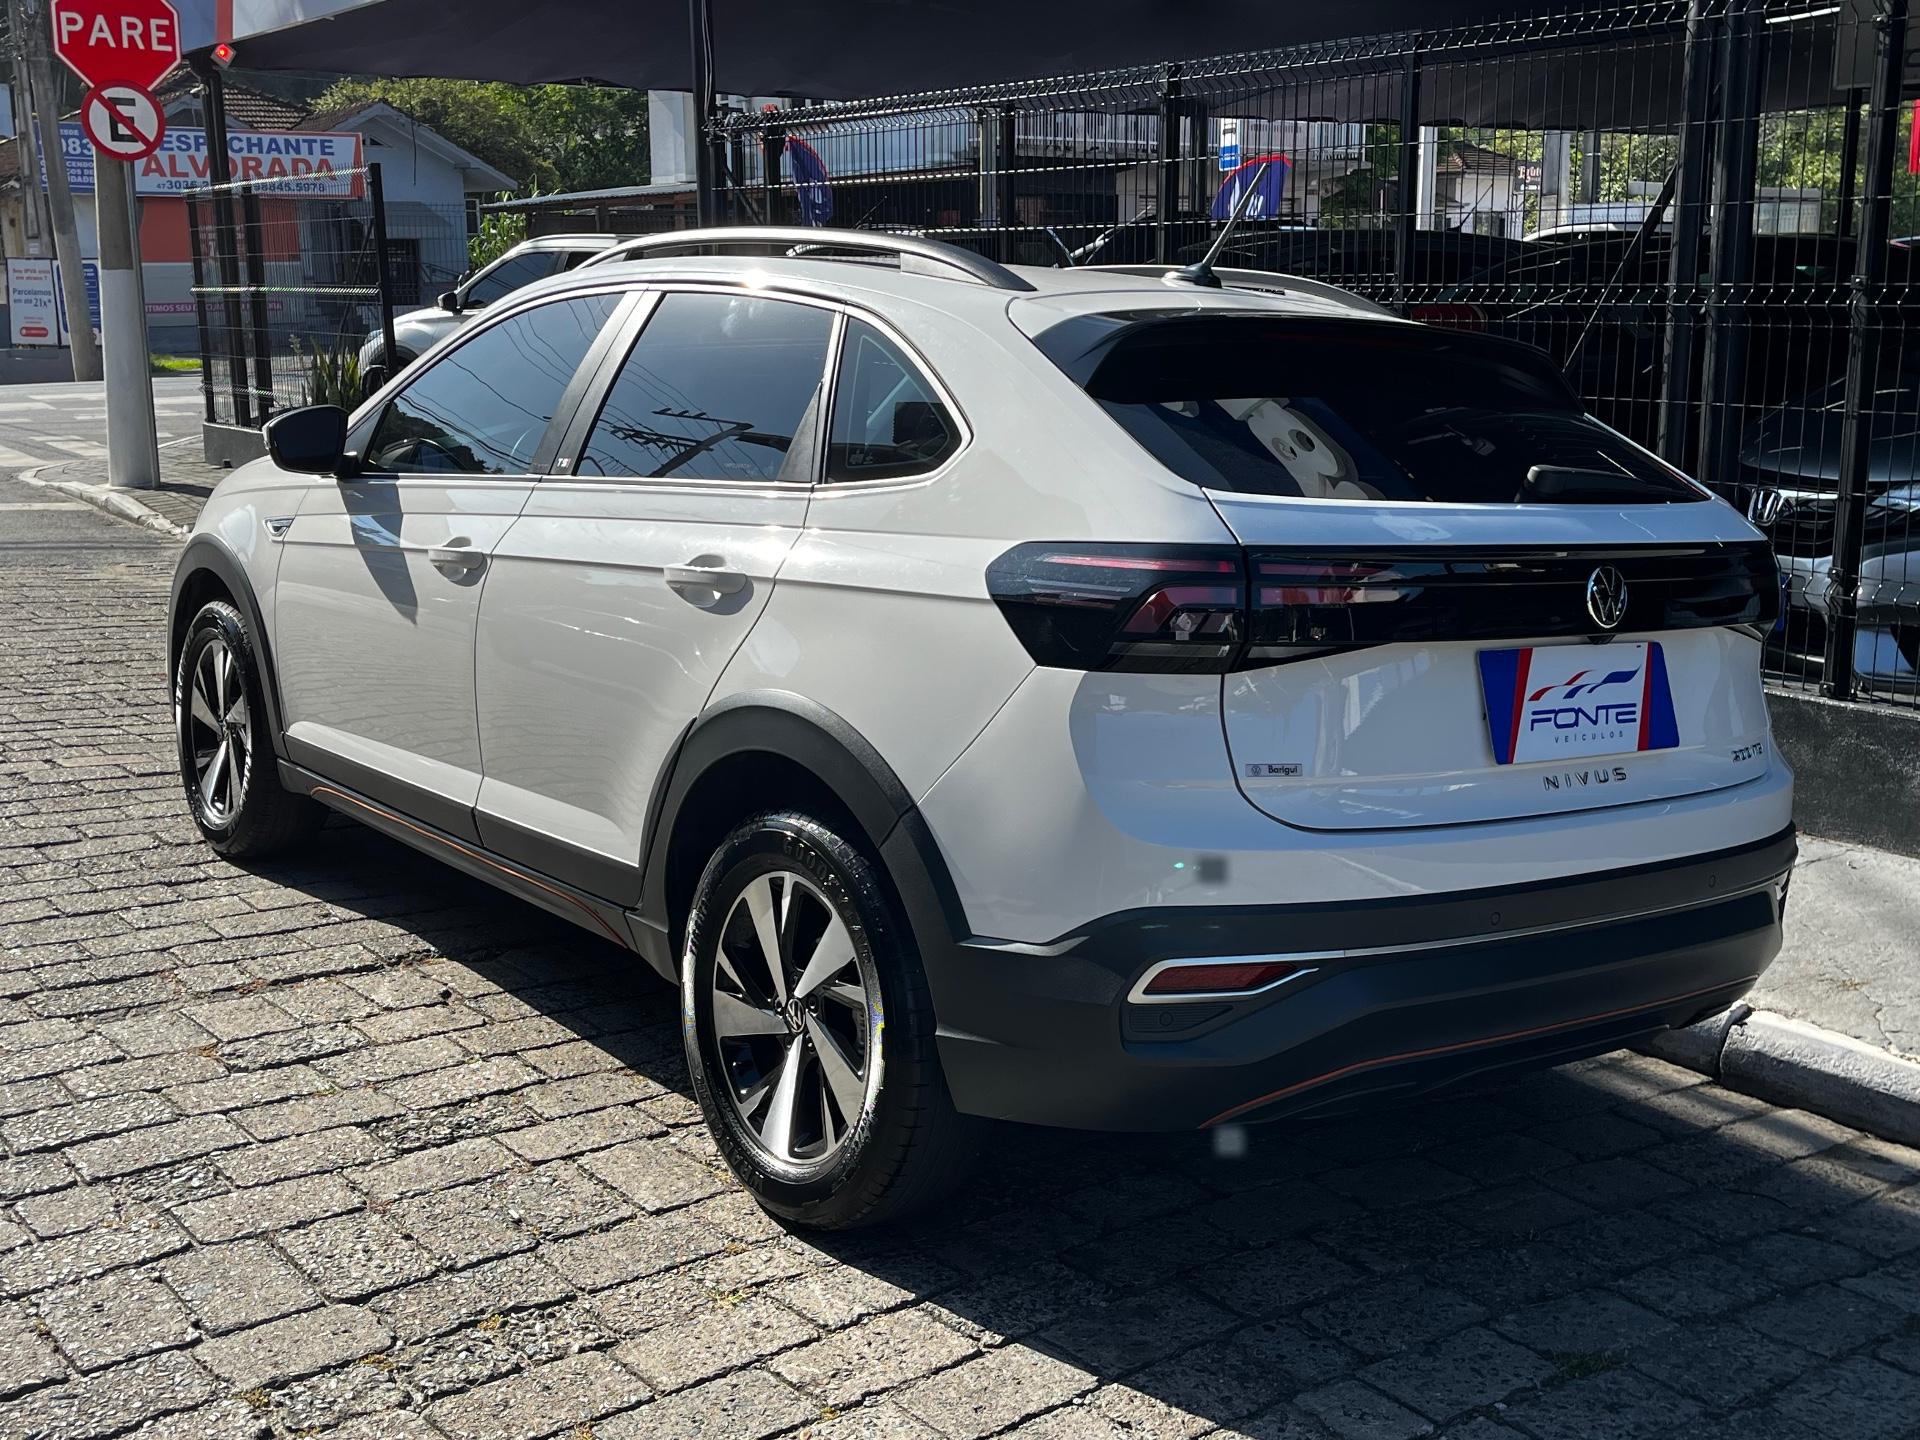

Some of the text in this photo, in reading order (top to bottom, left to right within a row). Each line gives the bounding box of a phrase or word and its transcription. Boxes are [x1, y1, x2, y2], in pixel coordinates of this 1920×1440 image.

[59, 12, 173, 52] PARE
[108, 97, 137, 142] E
[159, 133, 335, 157] ESPCHANTE
[12, 287, 52, 297] Parcelamos
[1530, 703, 1637, 731] FONTE
[1554, 730, 1624, 744] VEÍCULOS
[1267, 764, 1298, 776] Barigui
[1543, 767, 1627, 791] NIVUS
